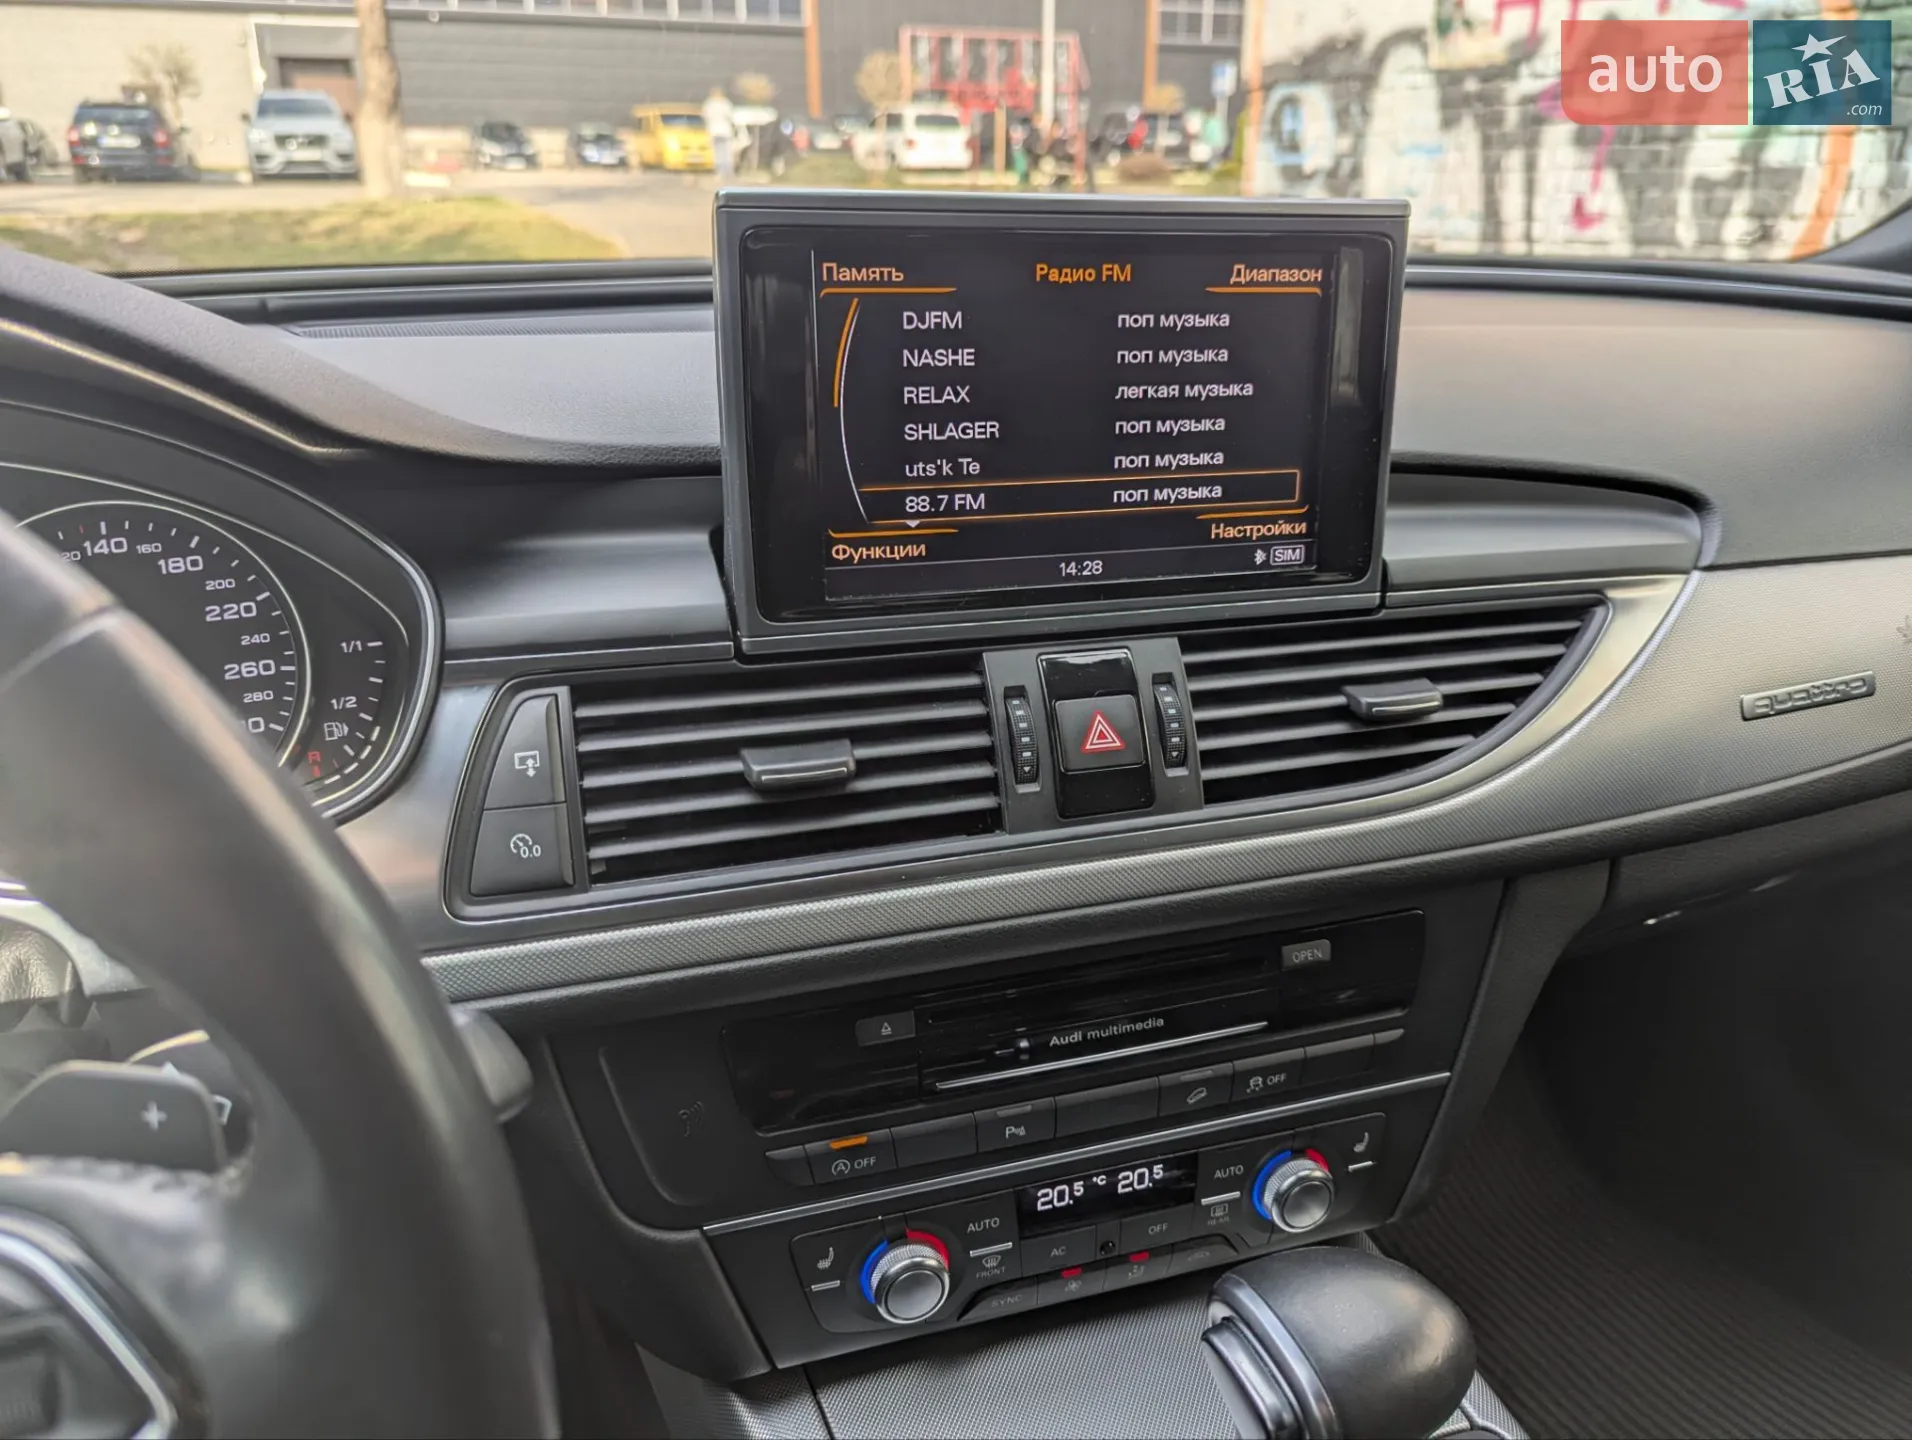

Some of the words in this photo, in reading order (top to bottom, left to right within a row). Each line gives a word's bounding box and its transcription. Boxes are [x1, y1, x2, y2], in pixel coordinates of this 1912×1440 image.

[822, 262, 904, 282] Память
[1035, 263, 1096, 284] Радио
[1102, 263, 1132, 282] FM
[1230, 264, 1322, 285] Диапазон
[903, 311, 963, 330] DJFM
[1118, 314, 1154, 329] поп
[1160, 312, 1230, 331] музыка
[903, 348, 976, 368] NASHE
[1117, 350, 1153, 364] поп
[1158, 347, 1229, 367] музыка
[903, 385, 971, 405] RELAX
[1115, 383, 1180, 400] легкая
[1184, 381, 1254, 401] музыка
[904, 421, 1000, 441] SHLAGER
[1115, 420, 1151, 435] поп
[1156, 417, 1226, 436] музыка
[905, 459, 953, 477] uts'k
[958, 458, 981, 475] Te
[1114, 454, 1150, 469] поп
[1154, 451, 1224, 470] музыка
[905, 495, 949, 513] 88.7
[954, 493, 986, 511] FM
[1113, 488, 1149, 503] поп
[1153, 484, 1223, 504] музыка
[1210, 519, 1307, 541] Настройки
[83, 537, 128, 556] 140
[136, 542, 162, 554] 160
[831, 544, 926, 564] Функции
[1274, 547, 1301, 562] SIM
[157, 555, 204, 575] 180
[1059, 560, 1103, 577] 14:28
[205, 578, 236, 591] 200
[205, 601, 257, 622] 220
[240, 632, 271, 646] 240
[341, 640, 362, 653] 1/1
[224, 659, 276, 681] 260
[243, 689, 274, 703] 280
[330, 696, 357, 710] 1/2
[1754, 677, 1868, 715] quattro
[520, 844, 541, 858] 0.0
[1292, 949, 1322, 963] OPEN
[1049, 1031, 1082, 1047] Audi
[1087, 1017, 1164, 1039] multimedia
[1267, 1073, 1287, 1086] OFF
[854, 1156, 876, 1169] OFF
[1214, 1165, 1244, 1179] AUTO
[1037, 1180, 1084, 1211] 20.5
[1117, 1164, 1164, 1194] 20.5
[967, 1217, 1000, 1234] AUTO
[1148, 1222, 1168, 1235] OFF
[1050, 1246, 1067, 1257] AC
